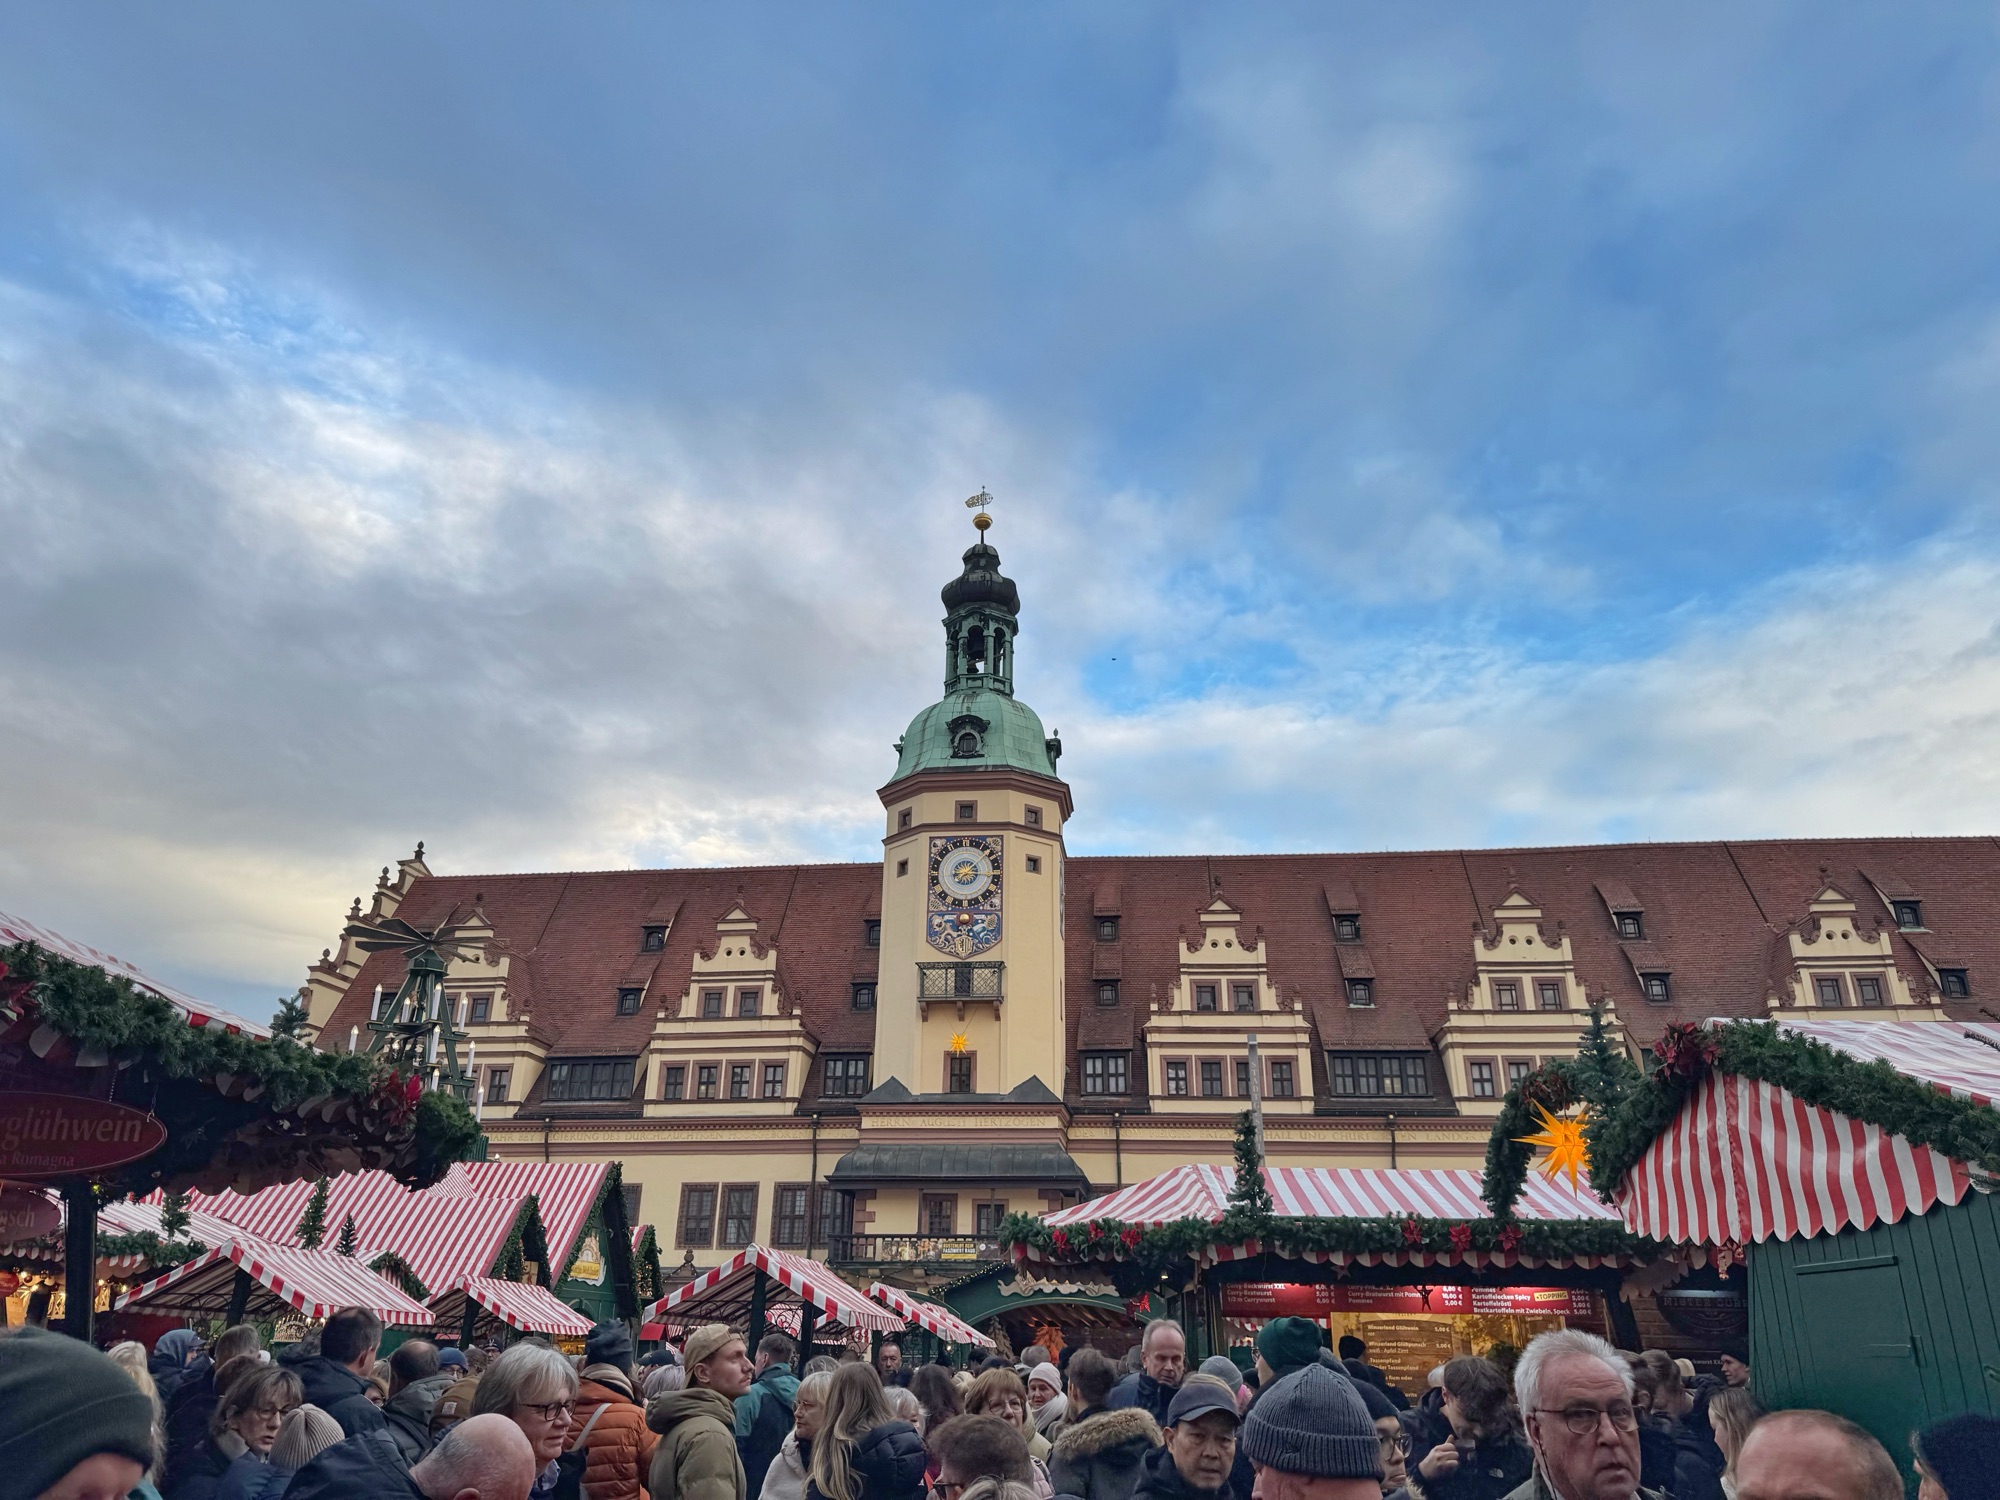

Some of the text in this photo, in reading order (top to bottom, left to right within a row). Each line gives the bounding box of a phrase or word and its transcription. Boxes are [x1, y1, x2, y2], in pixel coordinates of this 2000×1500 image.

[871, 1117, 910, 1127] HERRN
[974, 1116, 1046, 1127] HERTZOGEN
[518, 1132, 536, 1142] BEY
[602, 1131, 621, 1141] DES
[1074, 1128, 1095, 1138] DES
[1300, 1131, 1326, 1141] UND
[1426, 1131, 1489, 1142] LANDGRA
[1347, 1290, 1394, 1298] Curry-Bratwurst
[1514, 1293, 1531, 1301] Spicy
[1663, 1297, 1711, 1307] MISTER
[1553, 1308, 1570, 1316] Speck
